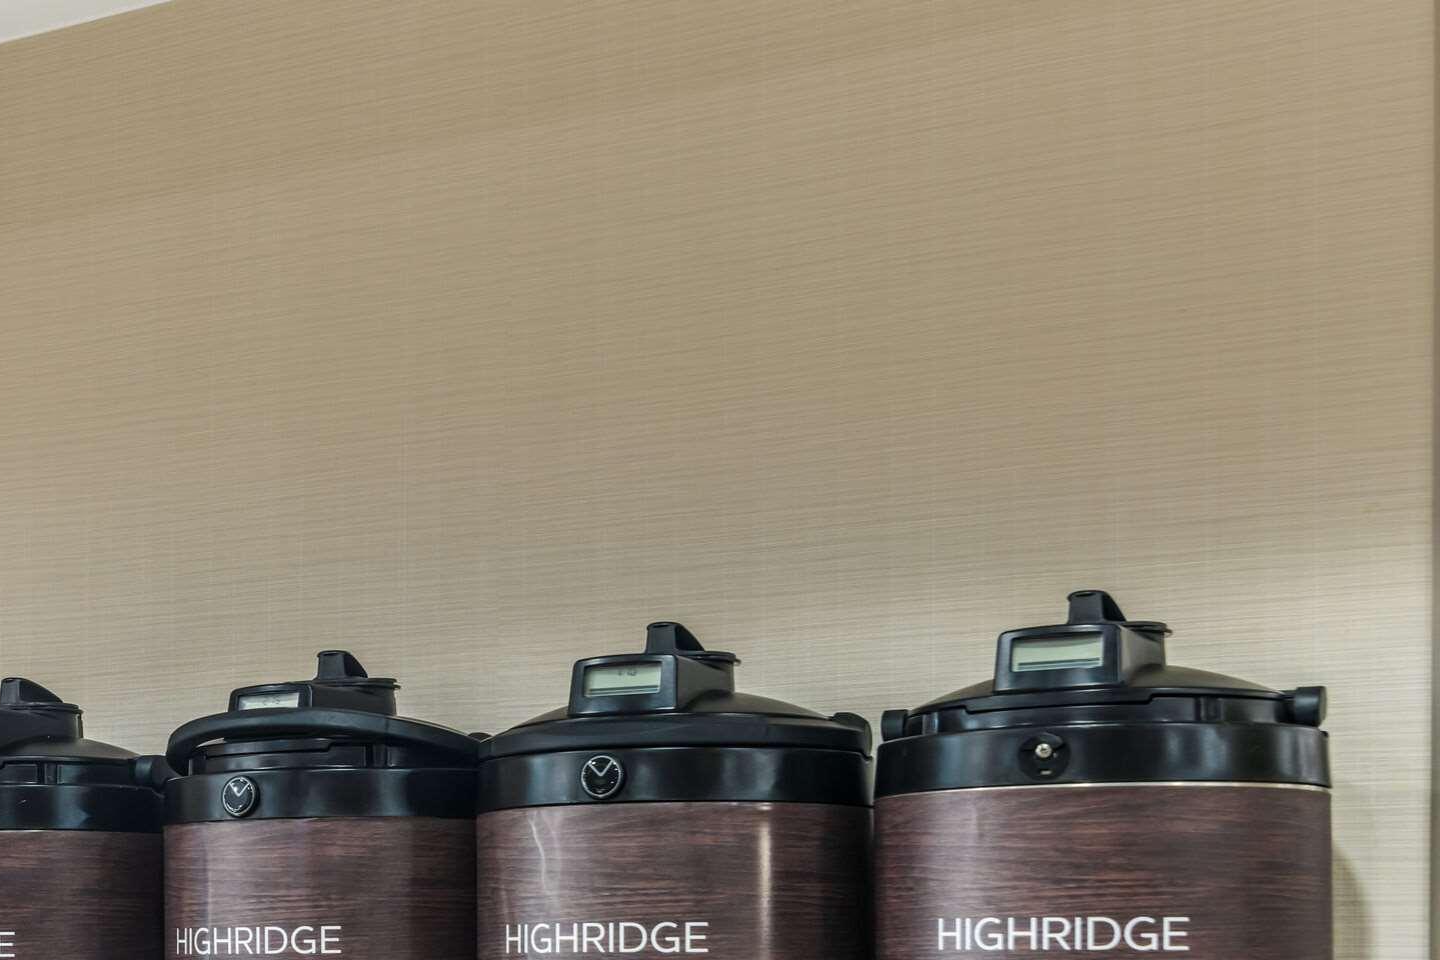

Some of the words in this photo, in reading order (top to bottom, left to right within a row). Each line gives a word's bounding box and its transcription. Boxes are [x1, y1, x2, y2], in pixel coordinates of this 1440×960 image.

[176, 925, 342, 955] HIGHRIDGE
[505, 921, 709, 954] HIGHRIDGE
[937, 916, 1190, 951] HIGHRIDGE
